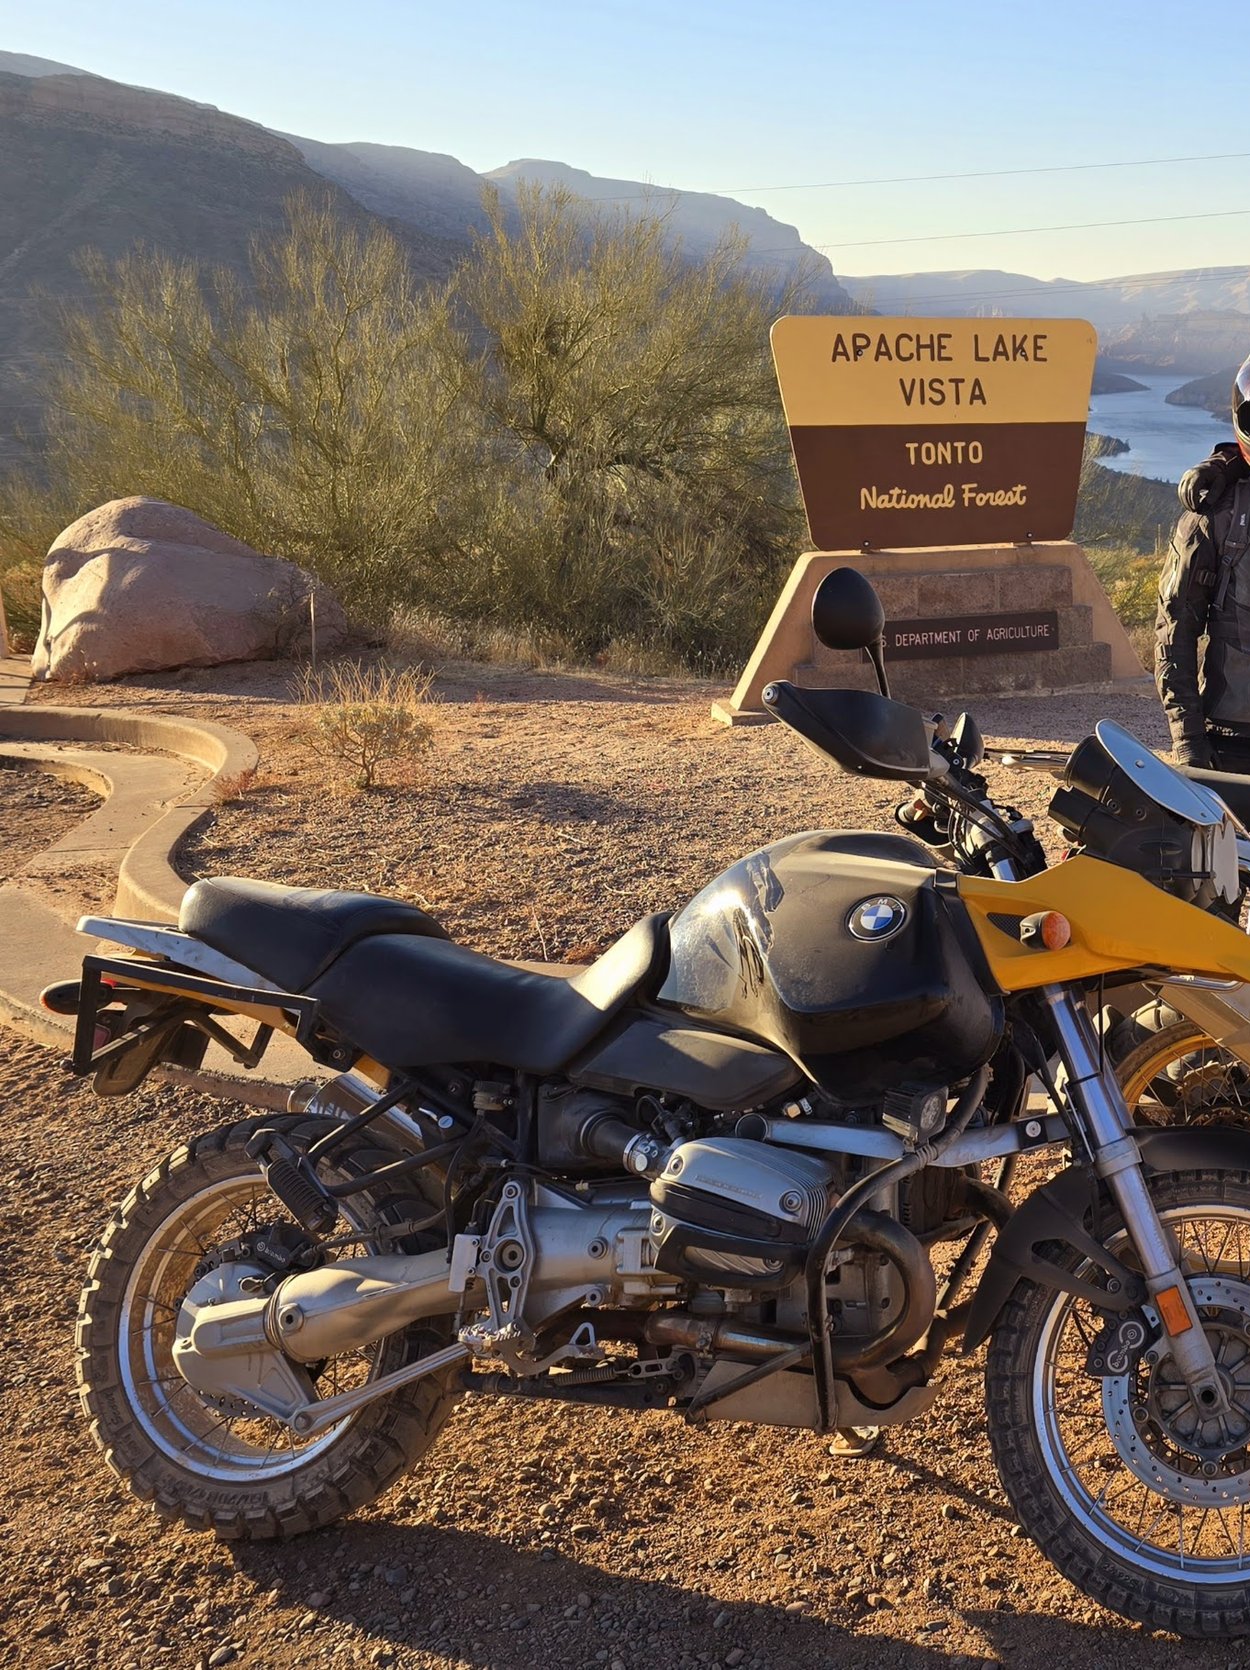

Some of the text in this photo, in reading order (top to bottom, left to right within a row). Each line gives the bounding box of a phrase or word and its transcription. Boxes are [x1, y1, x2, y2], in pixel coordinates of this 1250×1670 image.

[831, 333, 1048, 363] APACHE LAKE
[898, 377, 988, 406] VISTA
[905, 441, 984, 465] TONTO
[860, 482, 1027, 510] National Forest
[895, 630, 962, 647] DEPARTMENT
[967, 628, 980, 642] OF
[986, 624, 1050, 641] AGRICULTURE
